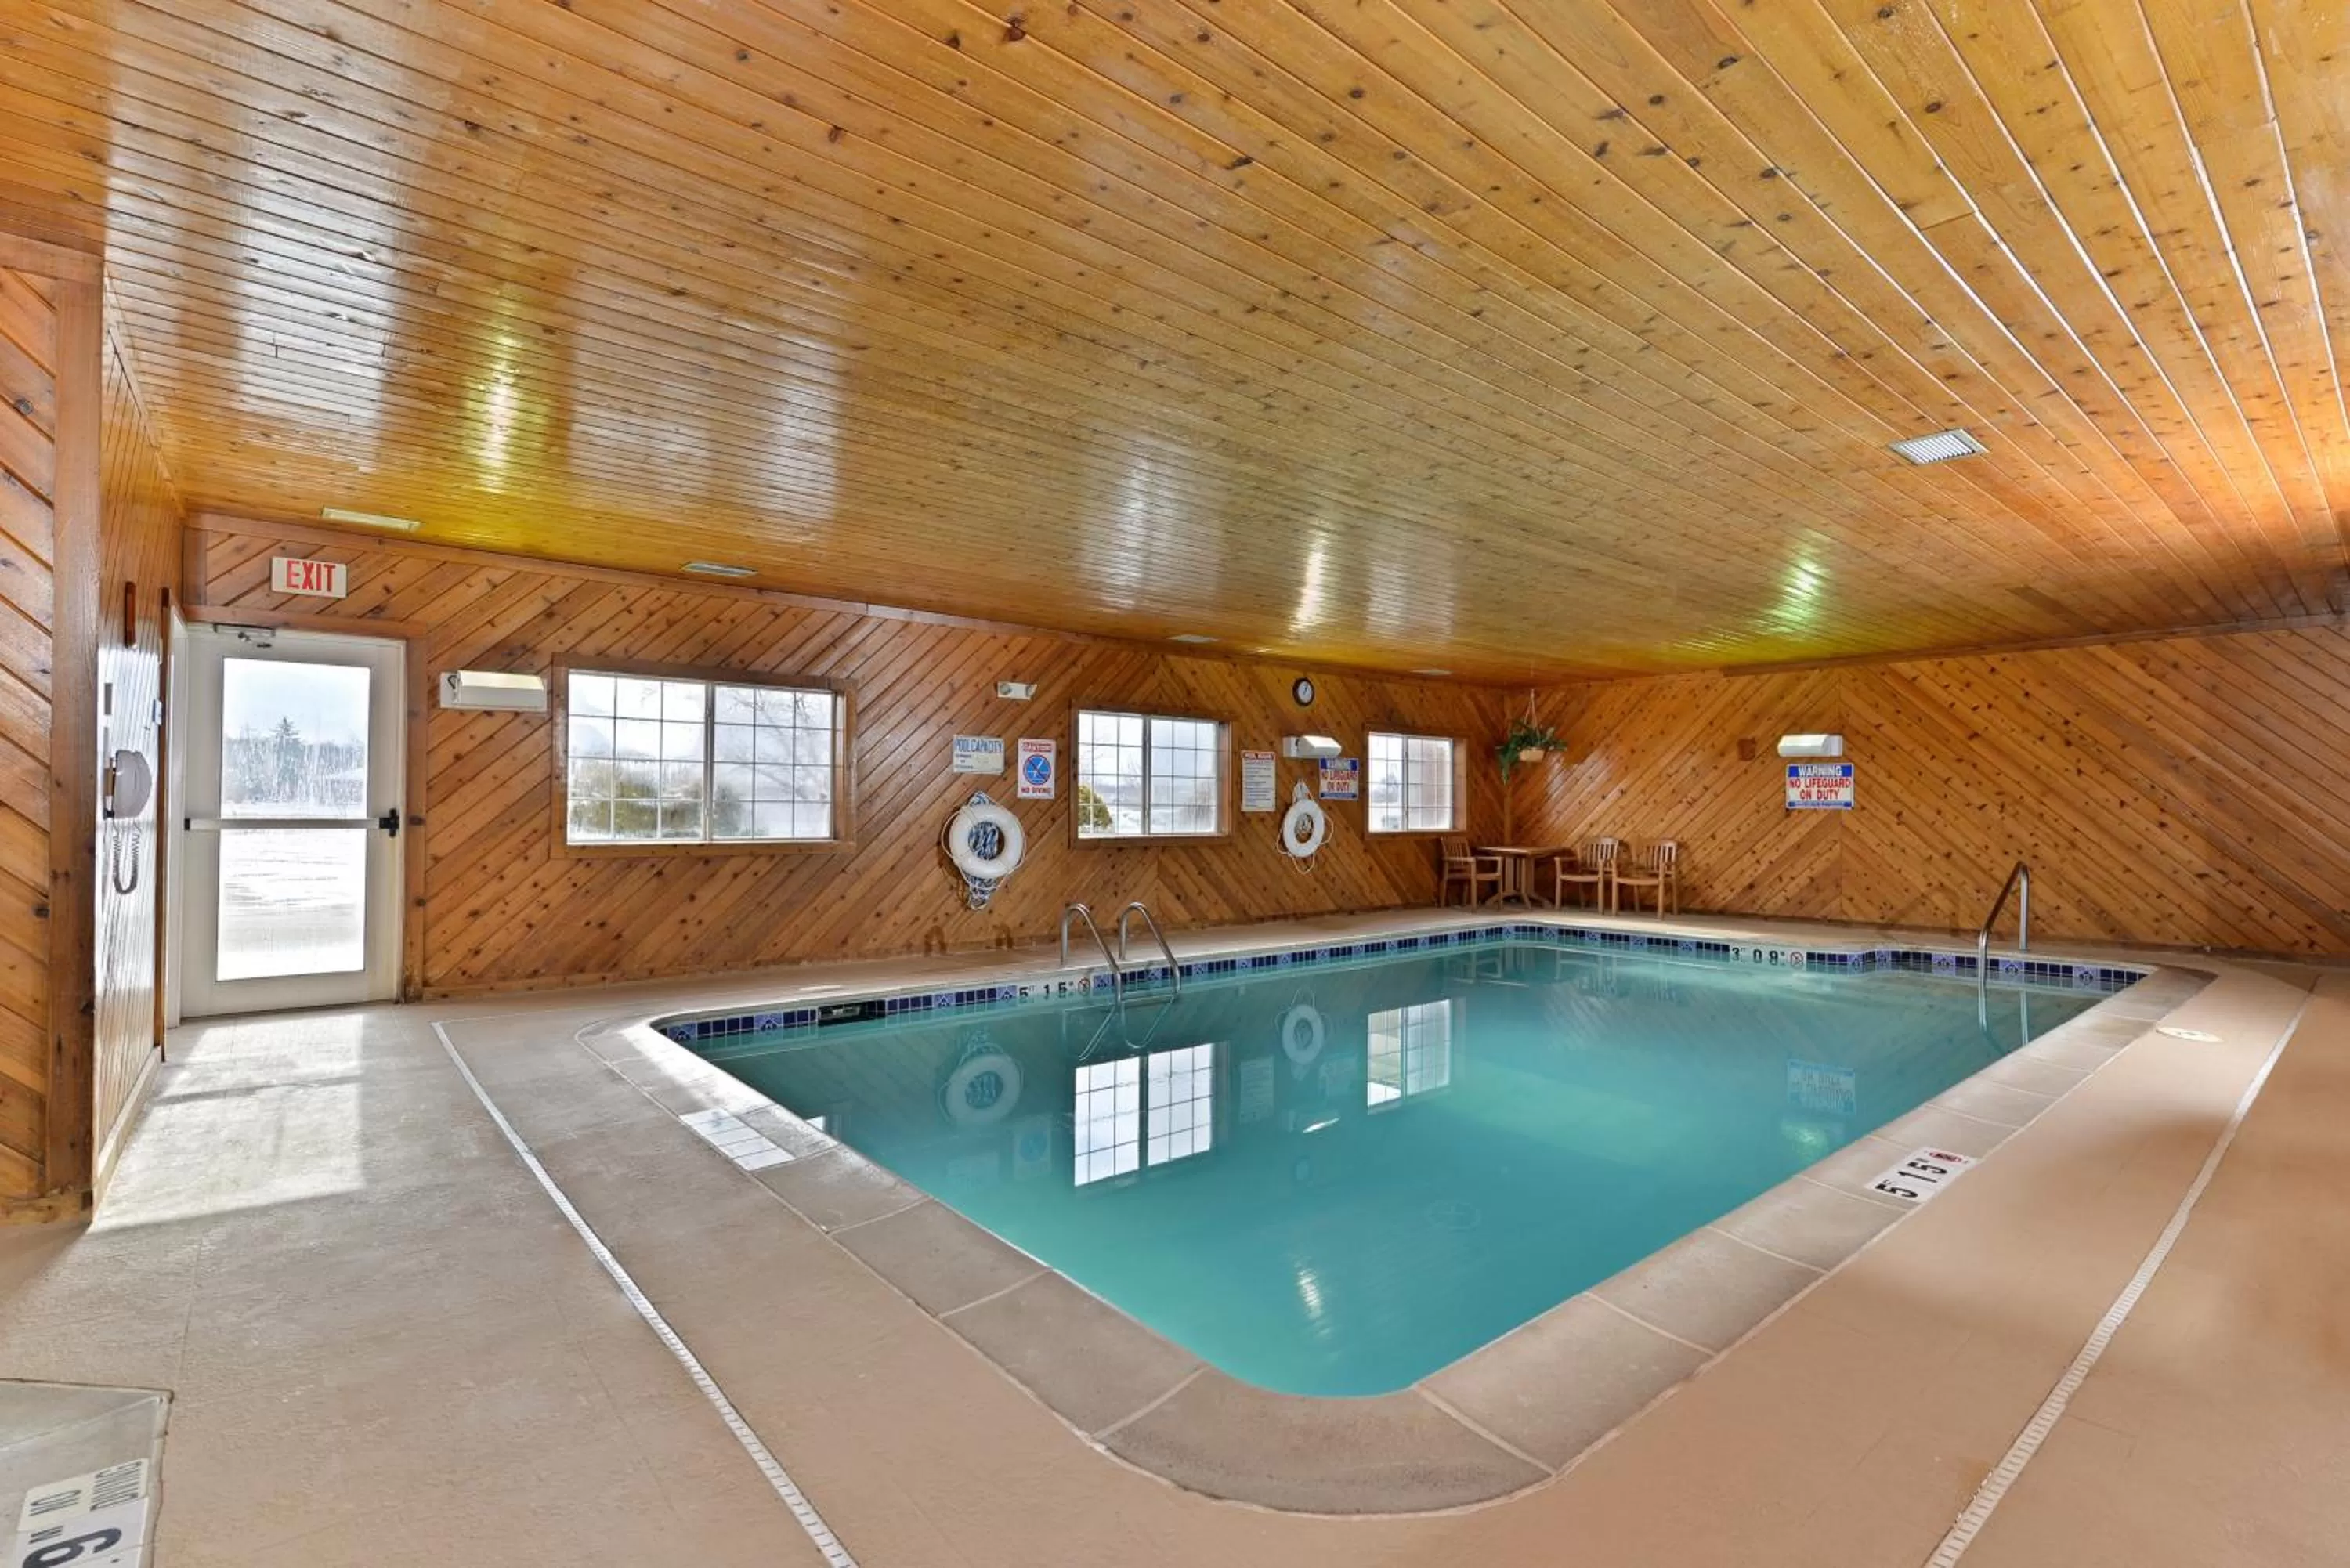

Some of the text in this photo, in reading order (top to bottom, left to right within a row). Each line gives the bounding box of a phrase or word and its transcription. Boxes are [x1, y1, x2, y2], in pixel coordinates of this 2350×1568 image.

[287, 561, 335, 591] EXIT
[1789, 778, 1850, 788] NO LIFEGUARD
[1800, 789, 1838, 800] ON DUTY
[90, 1461, 142, 1512] DIVING
[29, 1490, 81, 1517] NO
